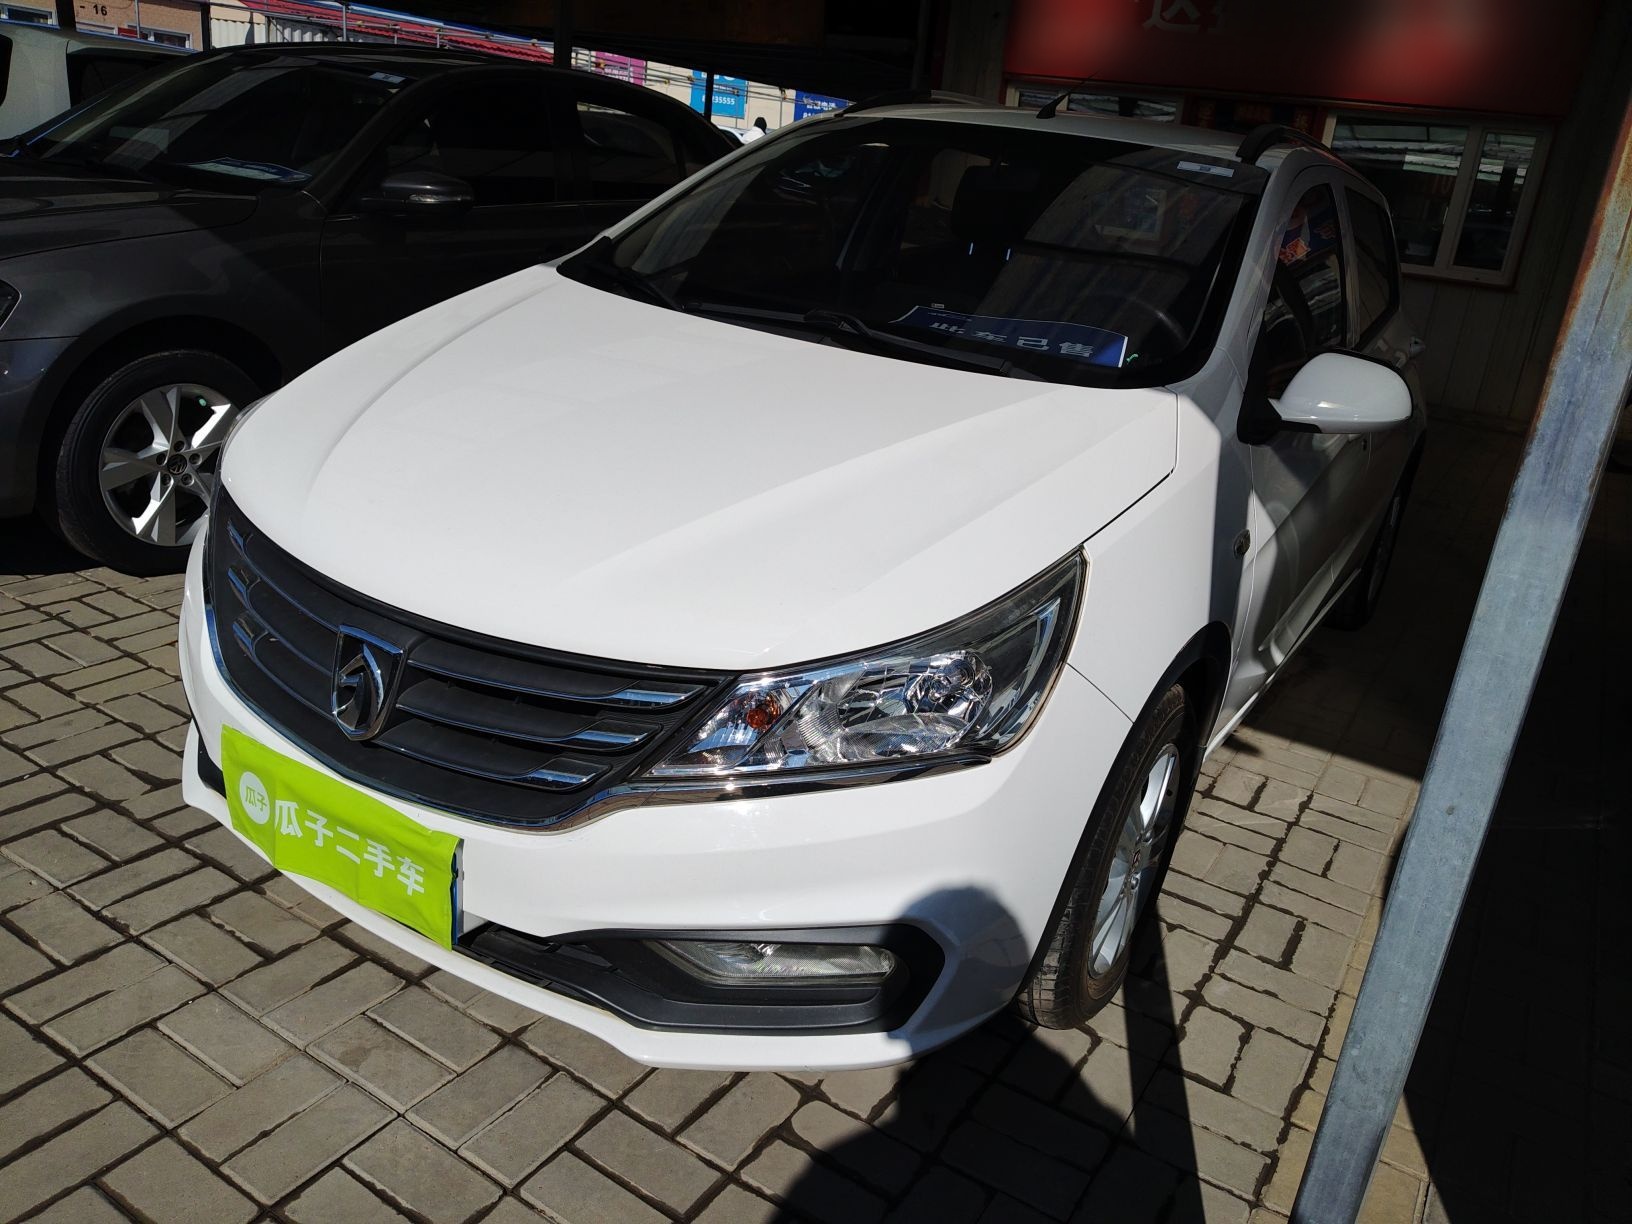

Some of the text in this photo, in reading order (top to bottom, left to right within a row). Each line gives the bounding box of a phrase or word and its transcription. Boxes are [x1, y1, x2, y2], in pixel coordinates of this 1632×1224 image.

[94, 4, 108, 16] 16
[244, 786, 268, 811] 瓜子
[274, 799, 425, 896] 瓜子二手车
